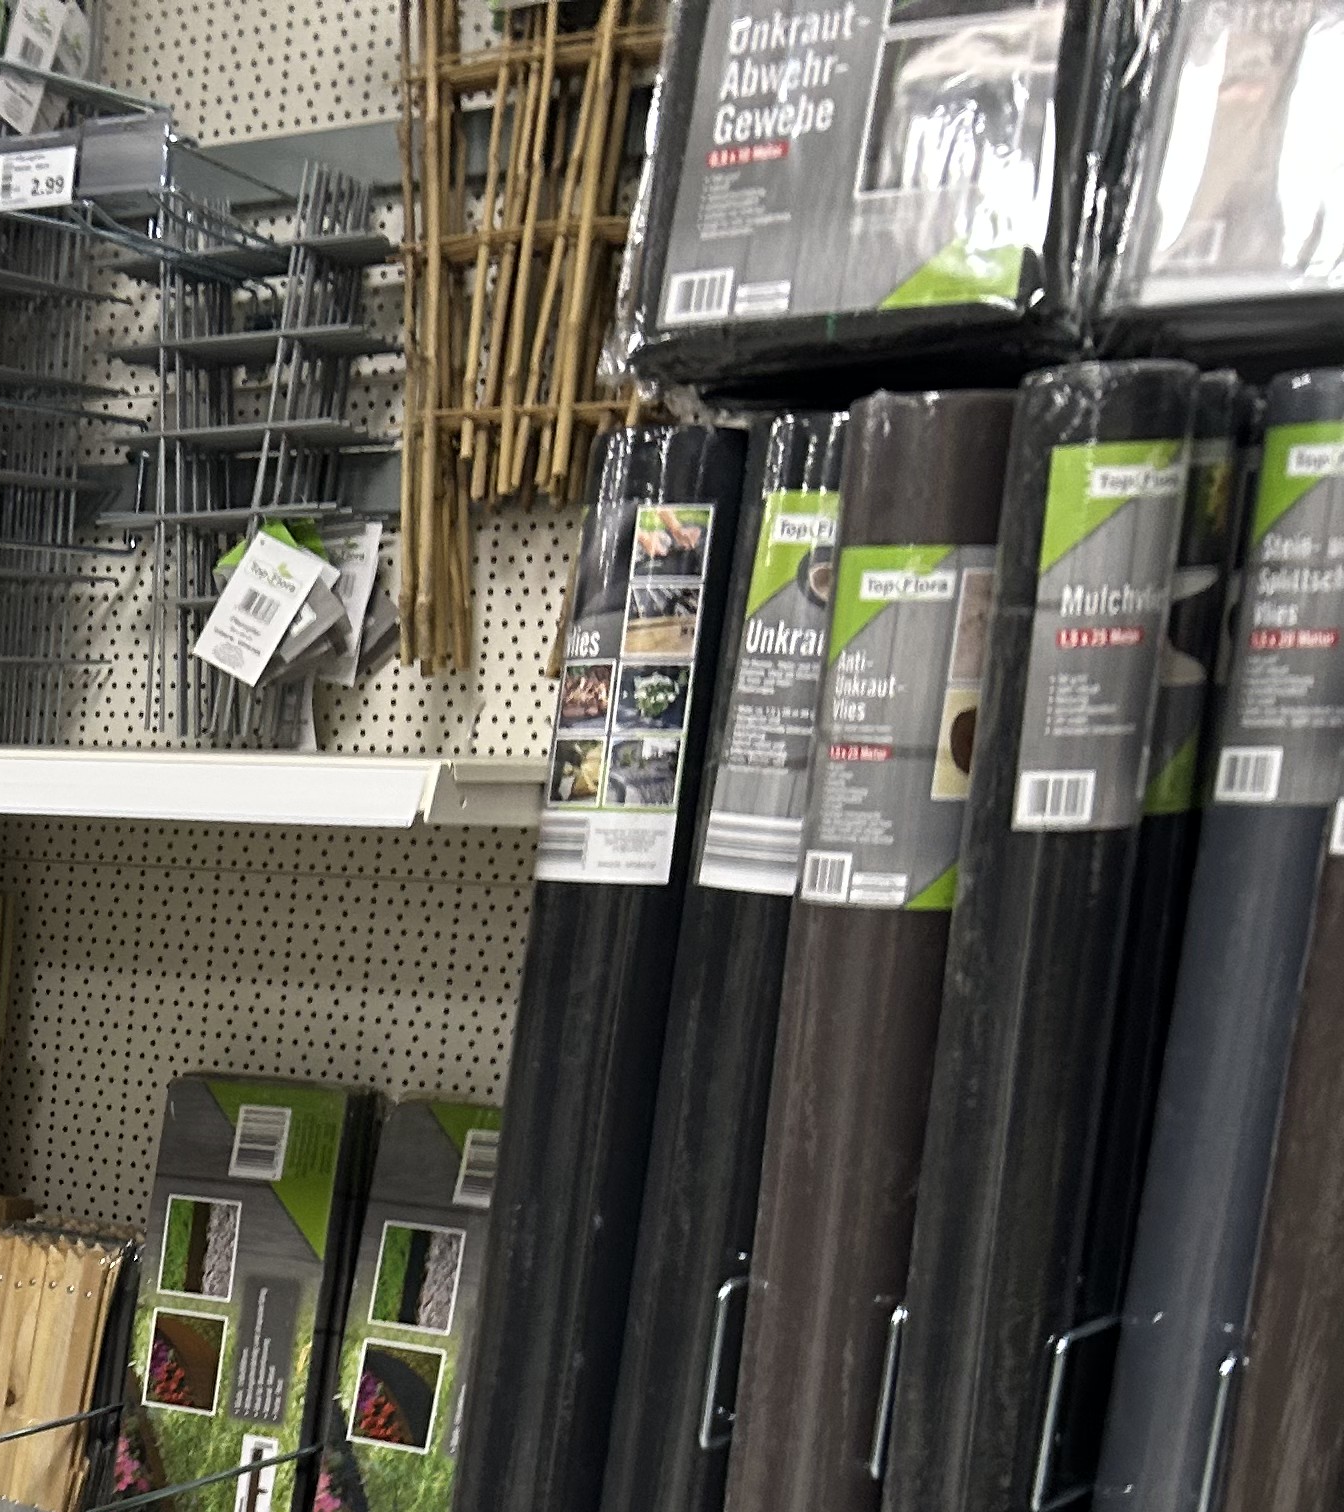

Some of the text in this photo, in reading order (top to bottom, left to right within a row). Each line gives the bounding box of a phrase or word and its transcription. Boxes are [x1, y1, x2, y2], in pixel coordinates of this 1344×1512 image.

[729, 0, 872, 55] Unkraut-
[719, 49, 850, 101] Abwehr-
[713, 94, 835, 145] Gewebe
[836, 650, 874, 673] Anti-
[834, 674, 908, 700] Unkraut-
[832, 699, 865, 722] Vlies
